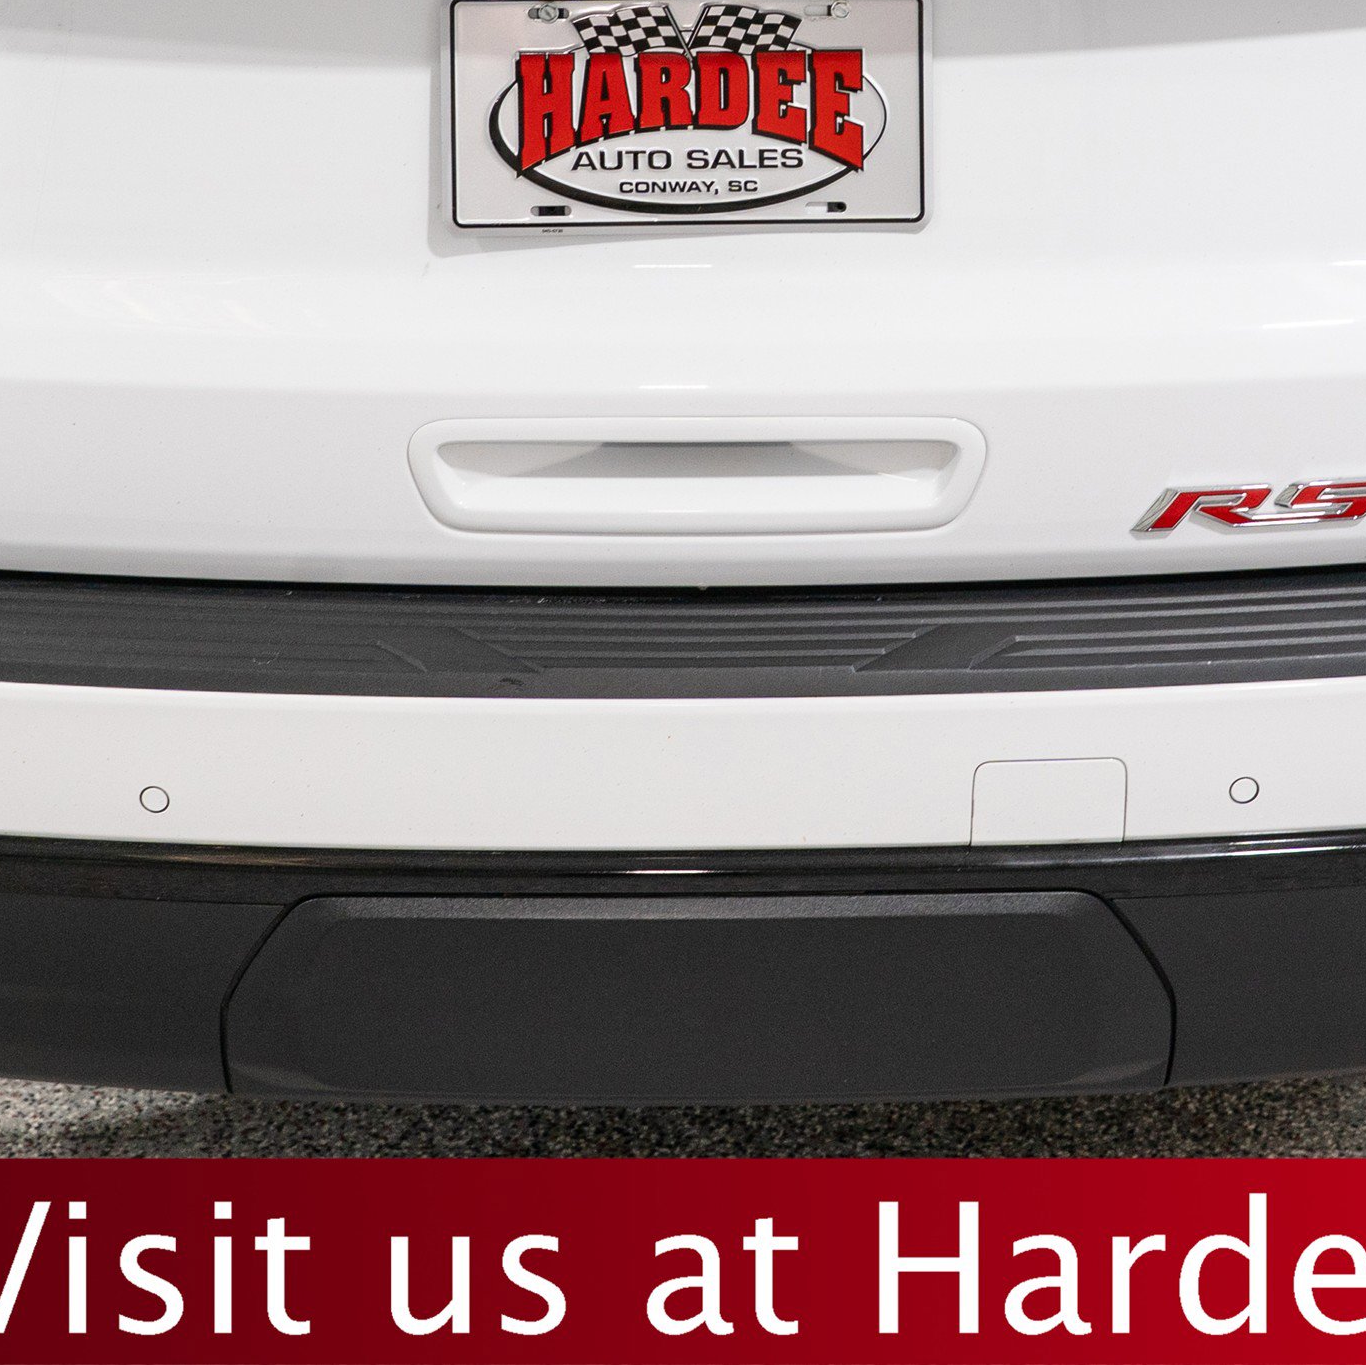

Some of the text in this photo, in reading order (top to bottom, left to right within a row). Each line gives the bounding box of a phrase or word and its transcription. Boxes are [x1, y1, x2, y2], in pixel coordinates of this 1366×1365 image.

[514, 49, 864, 178] HARDEE
[571, 148, 804, 171] AUTO SALES
[619, 180, 758, 196] CONWAY, SC
